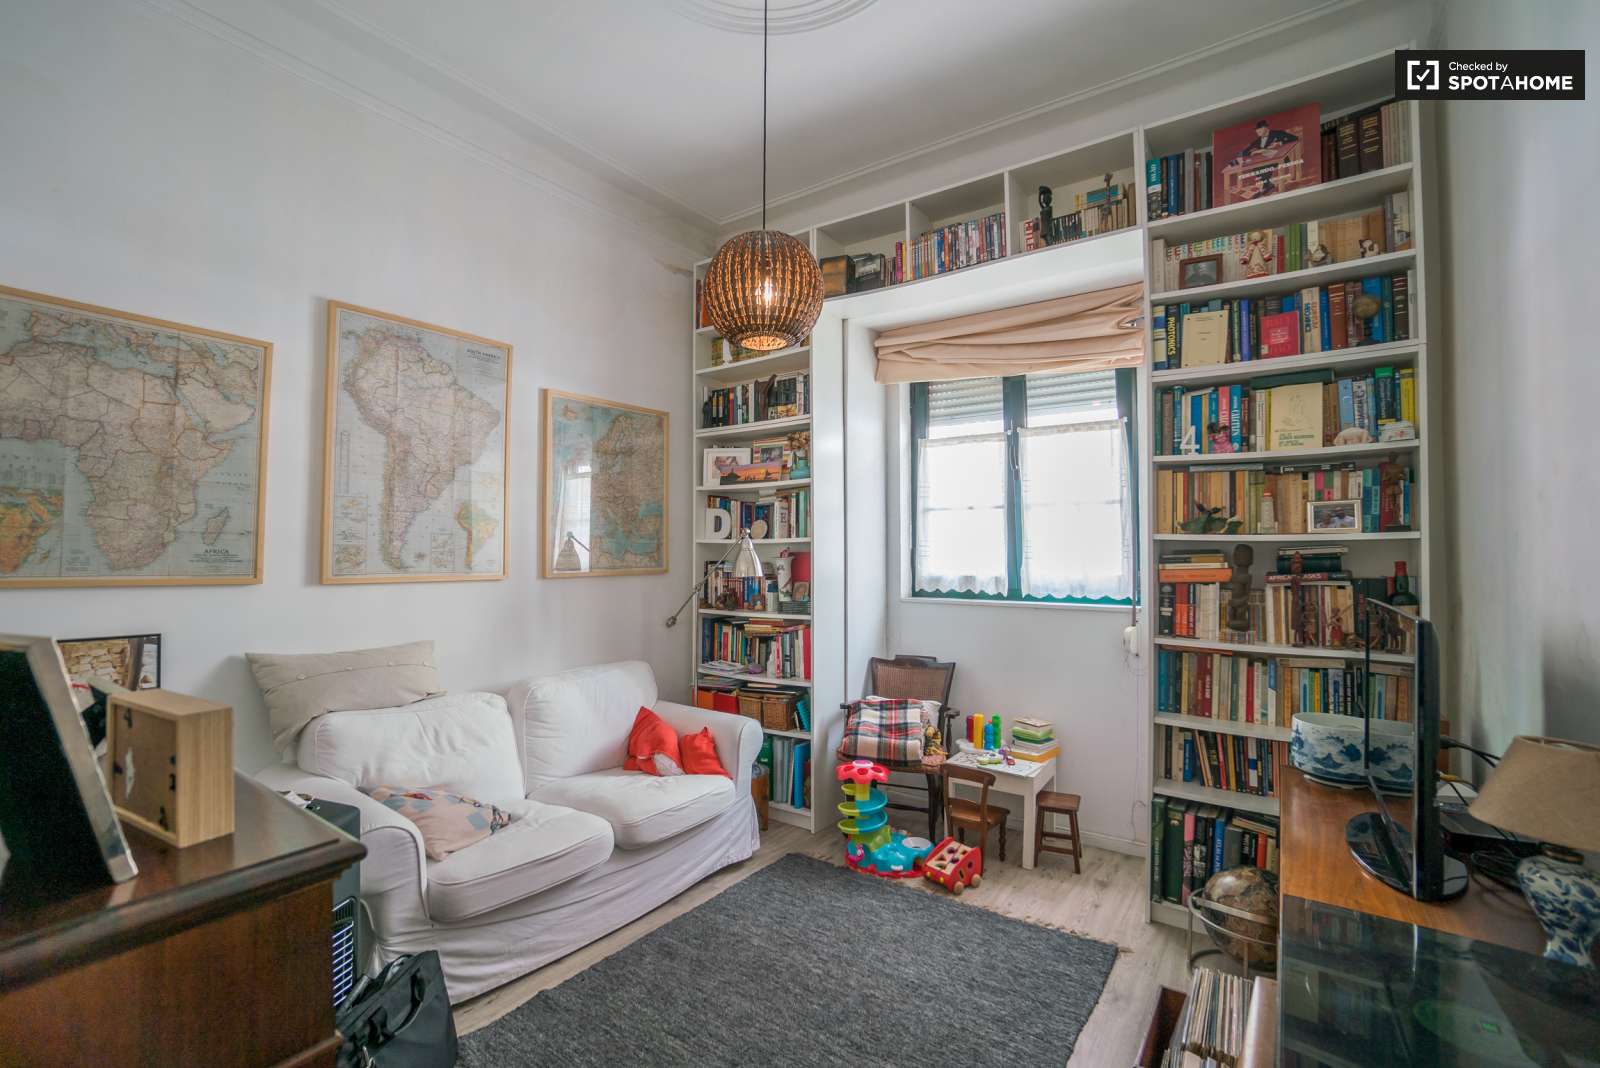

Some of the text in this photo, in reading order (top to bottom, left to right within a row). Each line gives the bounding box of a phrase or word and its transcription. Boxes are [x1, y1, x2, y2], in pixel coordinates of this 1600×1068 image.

[1166, 316, 1176, 356] PHOTONICS
[1180, 425, 1200, 455] 4
[704, 508, 732, 539] D
